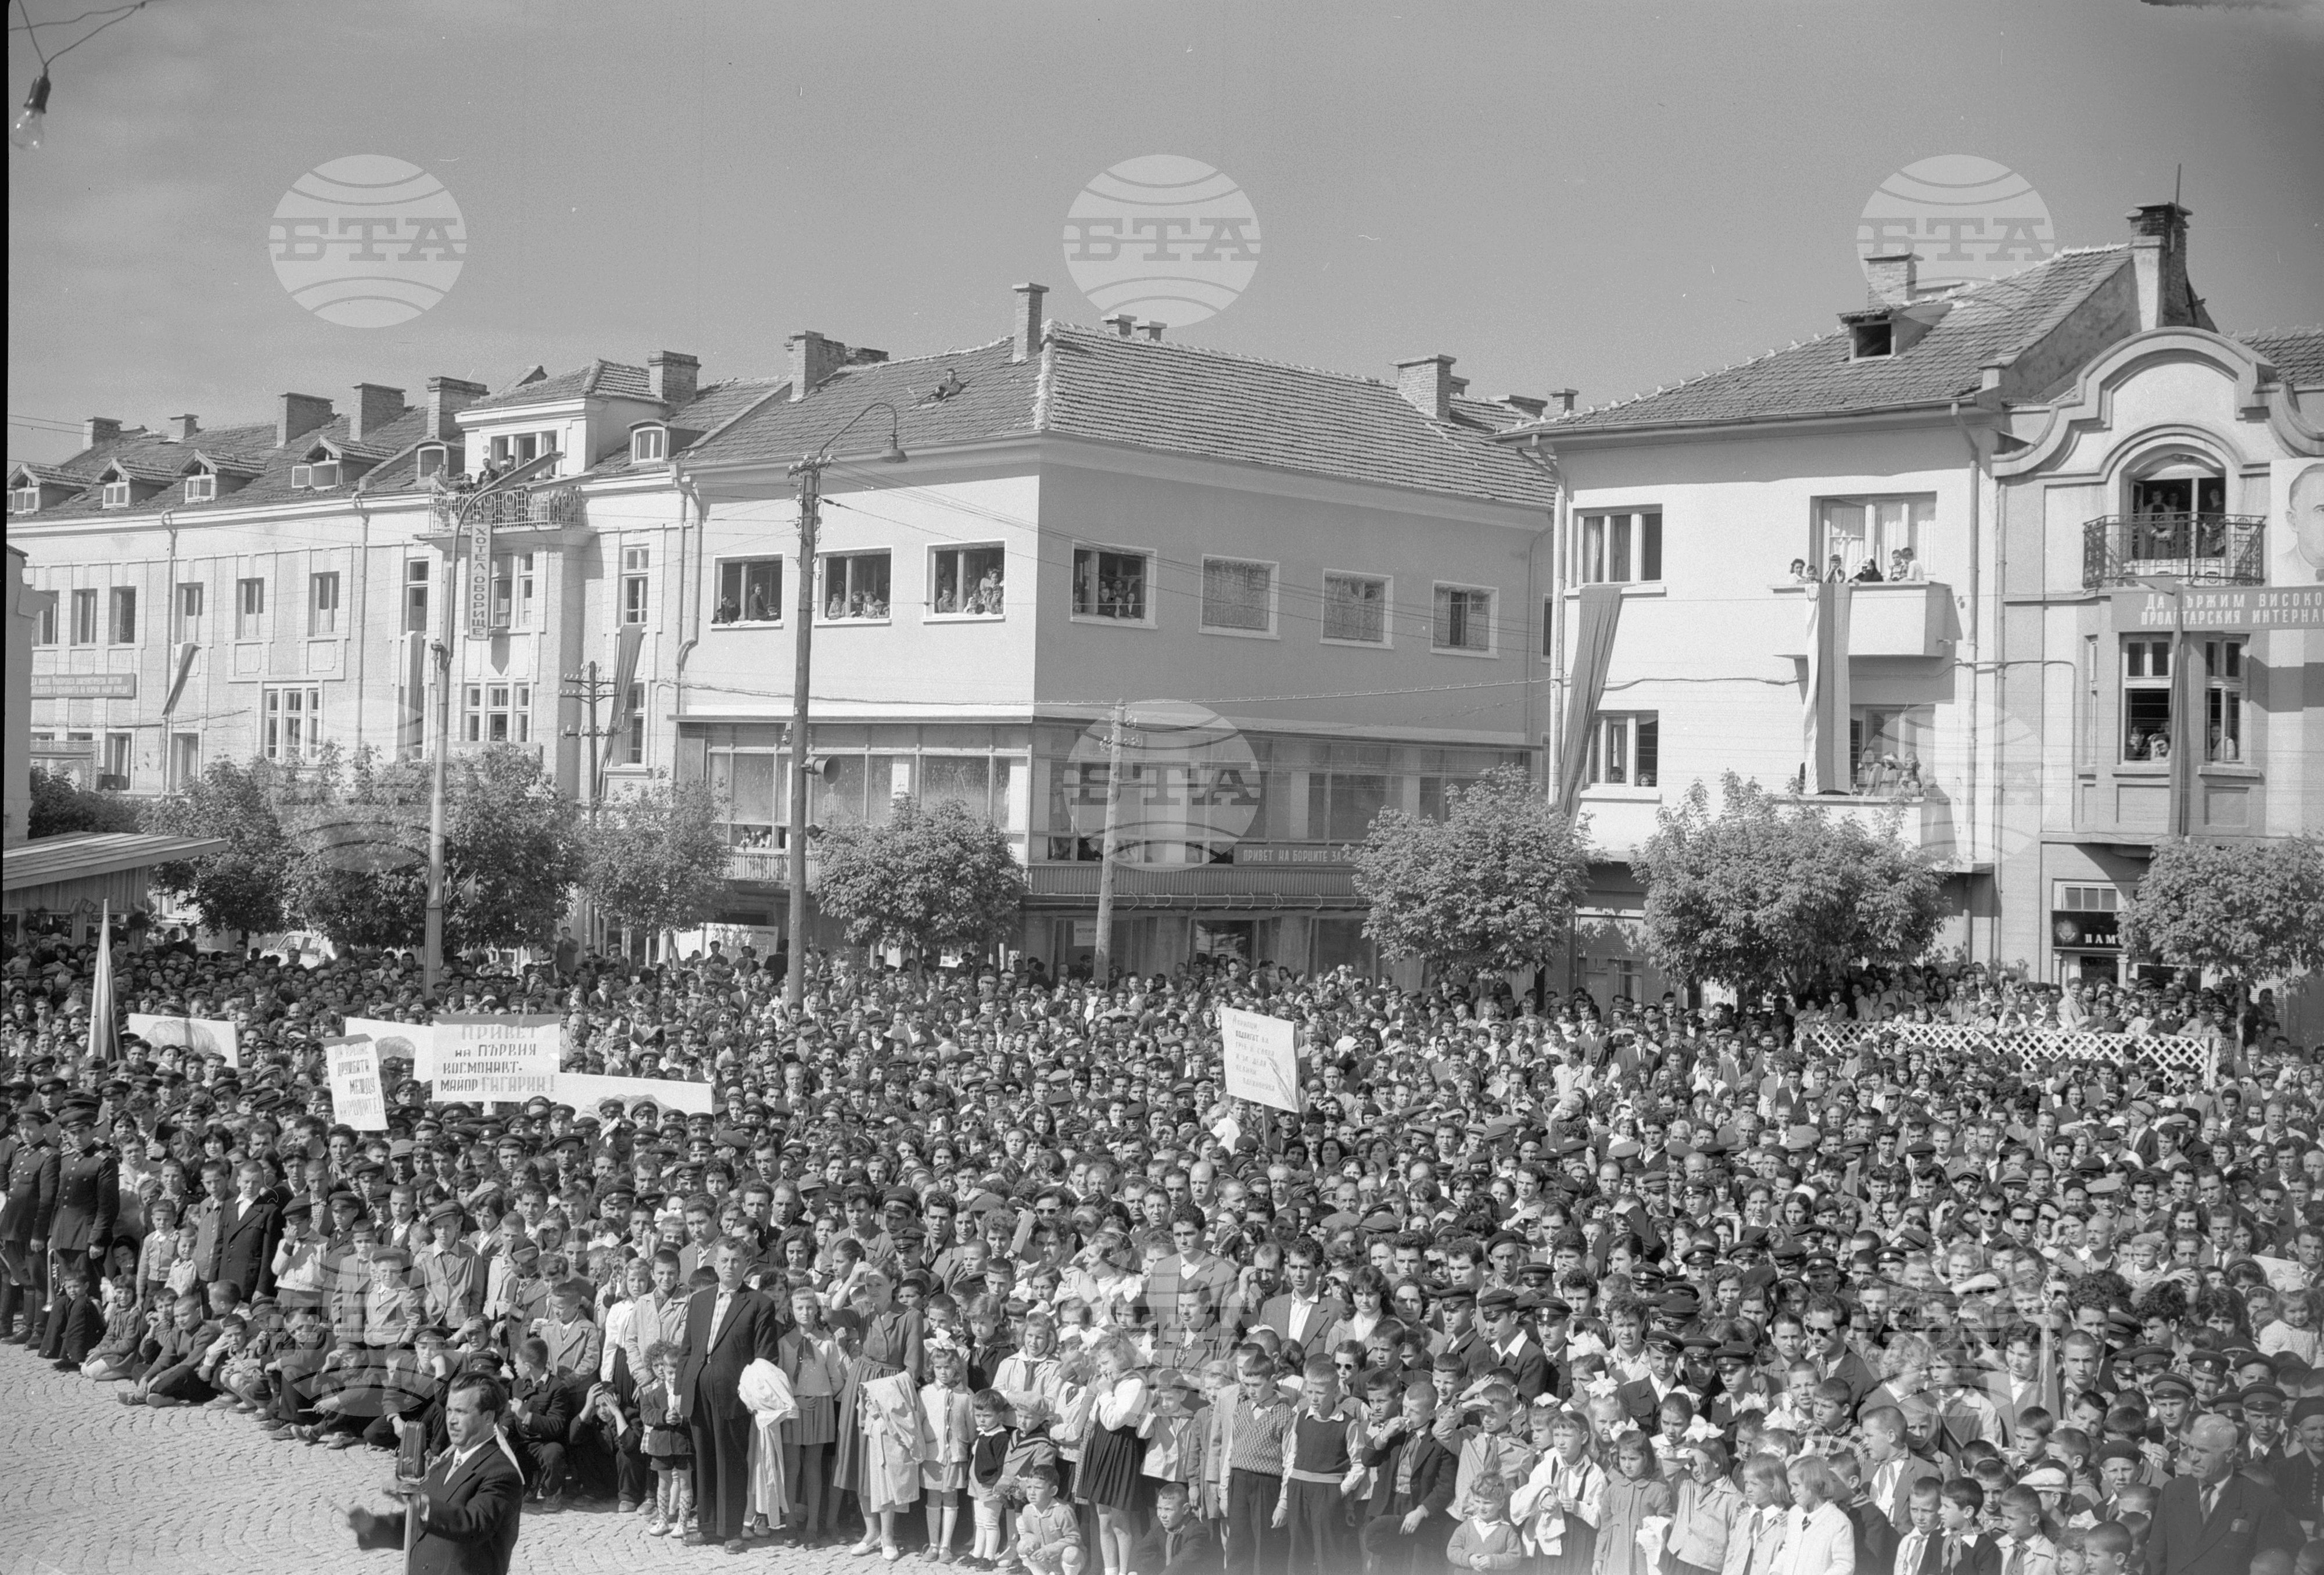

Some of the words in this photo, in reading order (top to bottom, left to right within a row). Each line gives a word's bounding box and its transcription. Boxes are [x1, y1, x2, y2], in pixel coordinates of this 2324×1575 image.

[474, 528, 487, 570] ХОТЕЛ
[2146, 594, 2164, 611] ДА
[2175, 594, 2245, 609] ЪРЖИМ
[2259, 592, 2322, 607] ВИСОКО
[2253, 609, 2324, 623] ИНТЕРНА
[1243, 849, 1274, 862] ПРИВЕТ
[1279, 850, 1289, 862] НА
[1292, 850, 1328, 862] БОРЦИТЕ
[1331, 851, 1342, 862] ЗА
[2085, 934, 2119, 944] ПАМ
[462, 1024, 535, 1039] ПРИВЕТ
[478, 1043, 536, 1057] ПЪРВИЯ
[338, 1059, 370, 1077] ДРУЖБАТА
[349, 1077, 375, 1095] МЕЖДУ
[440, 1077, 478, 1092] МАЙОР
